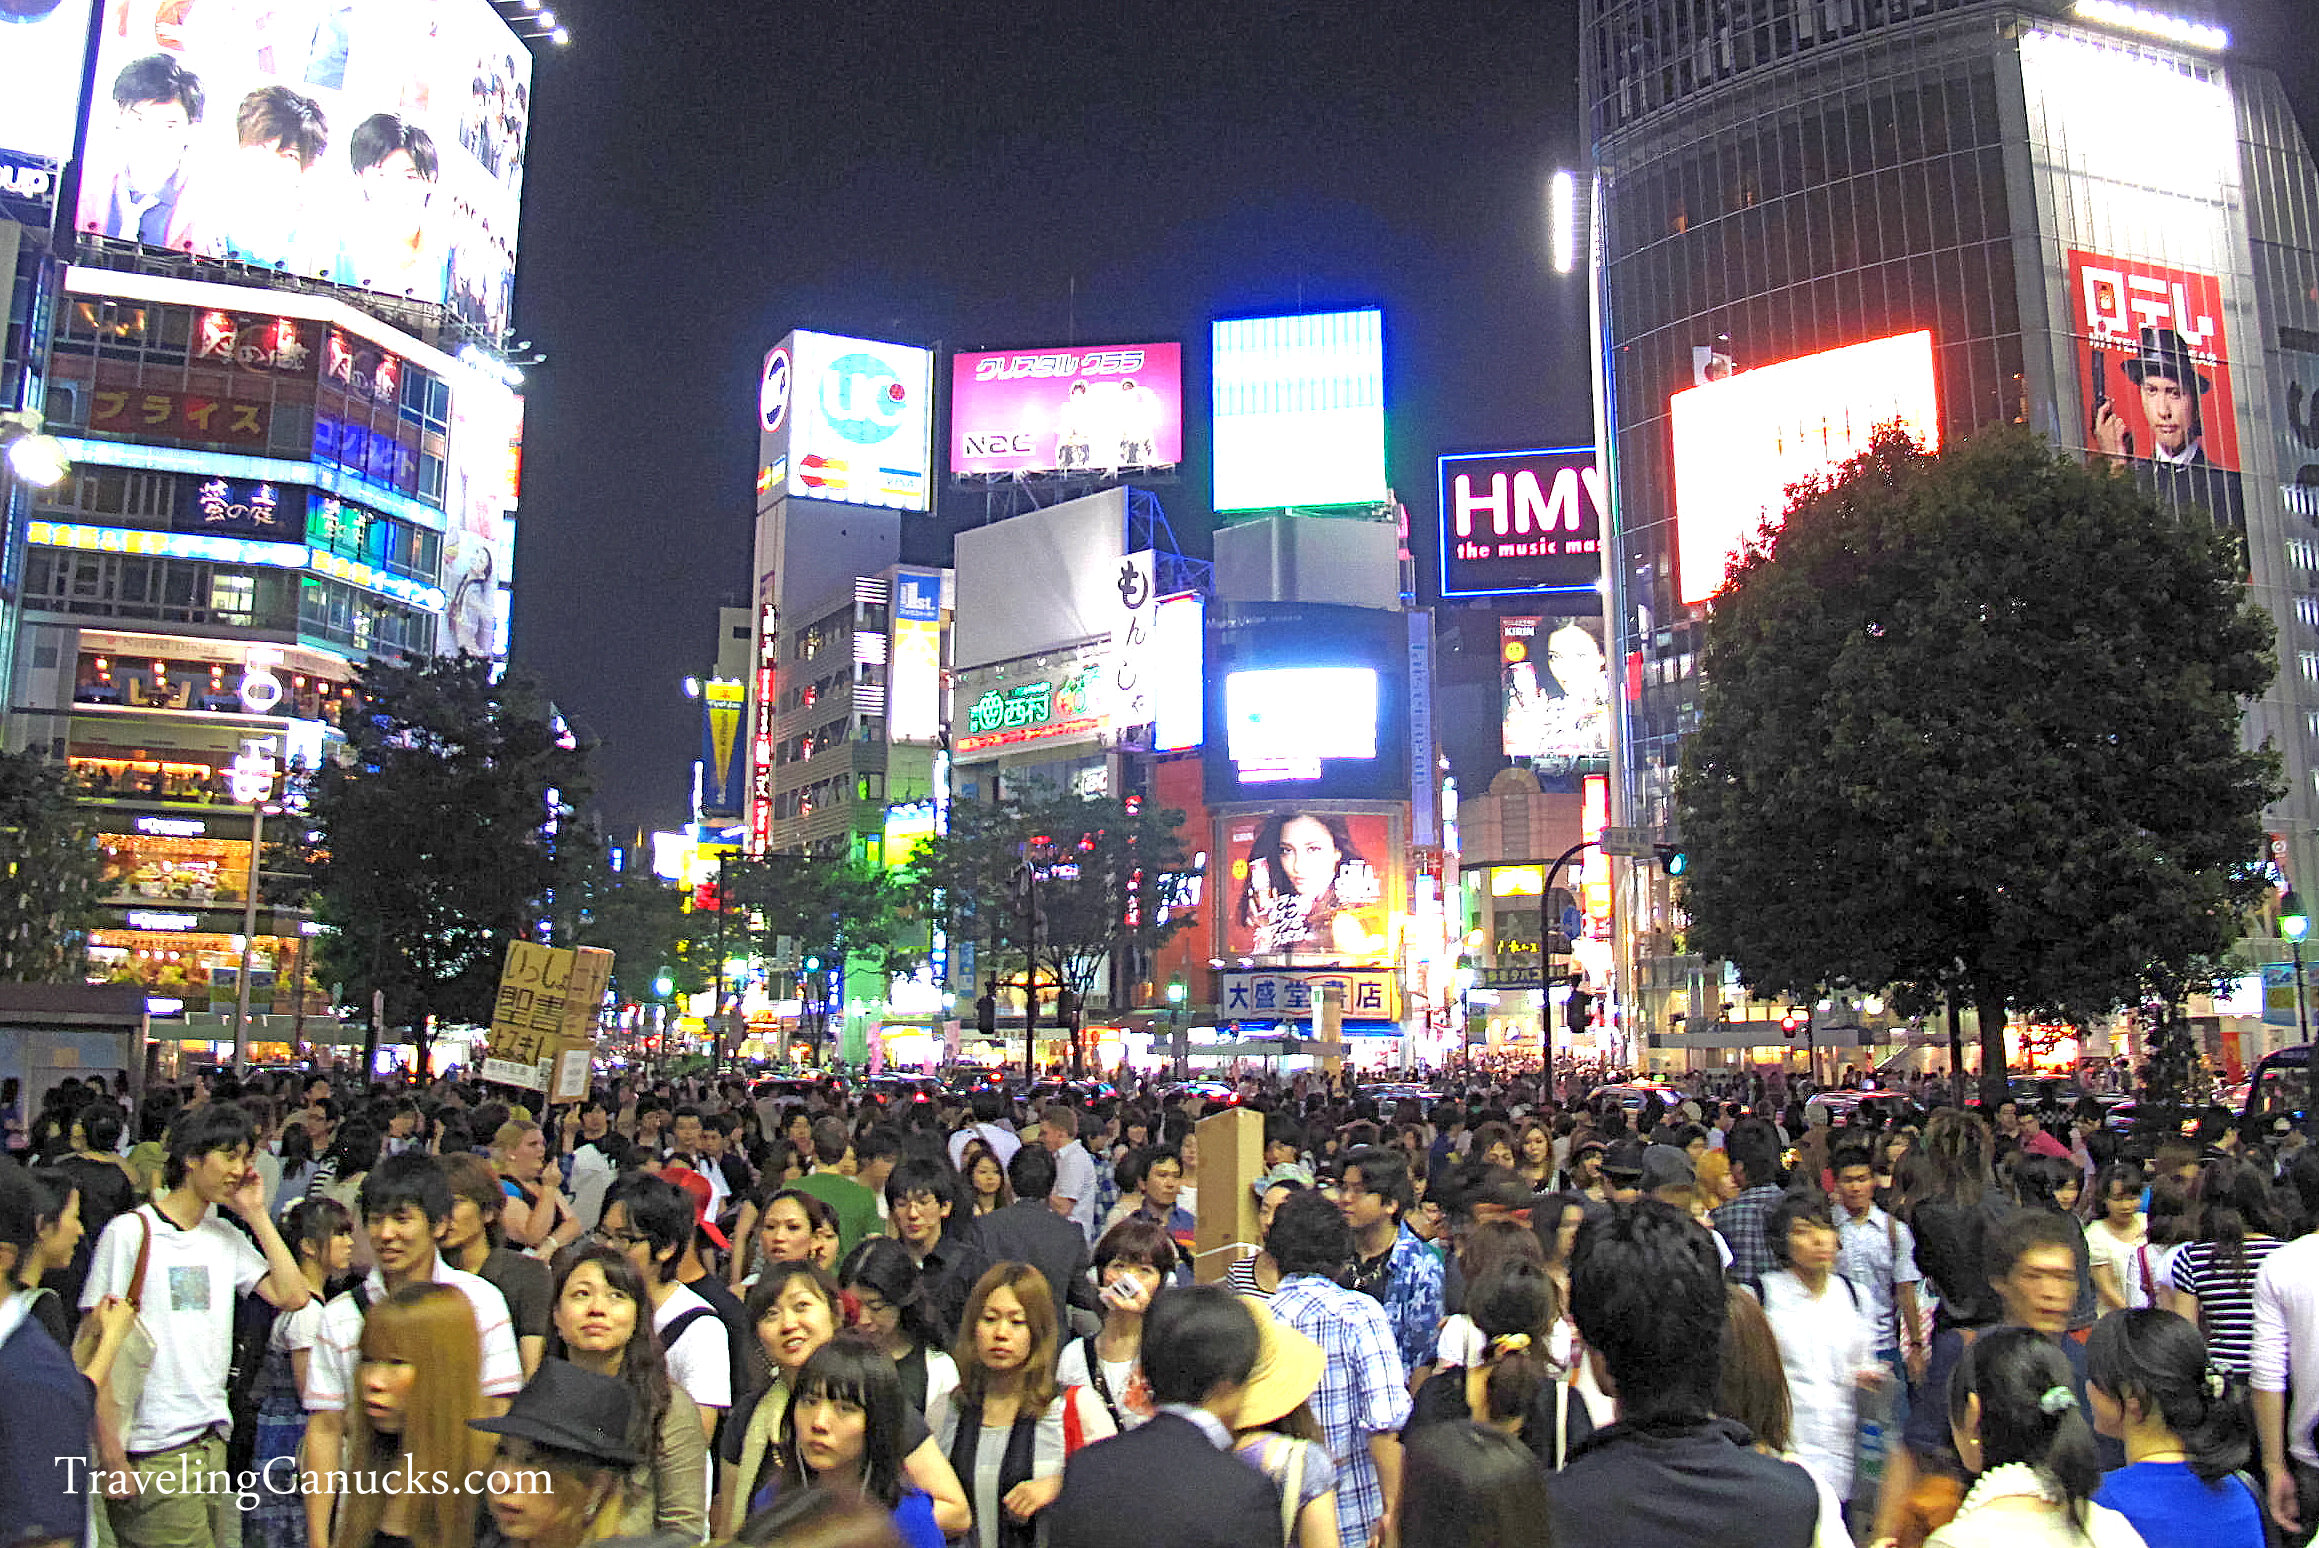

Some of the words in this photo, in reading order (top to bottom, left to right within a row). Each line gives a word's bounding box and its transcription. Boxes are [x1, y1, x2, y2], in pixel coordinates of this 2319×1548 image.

[1456, 540, 1491, 560] the
[1498, 536, 1558, 558] music
[1229, 979, 1382, 1012] 大盛堂店
